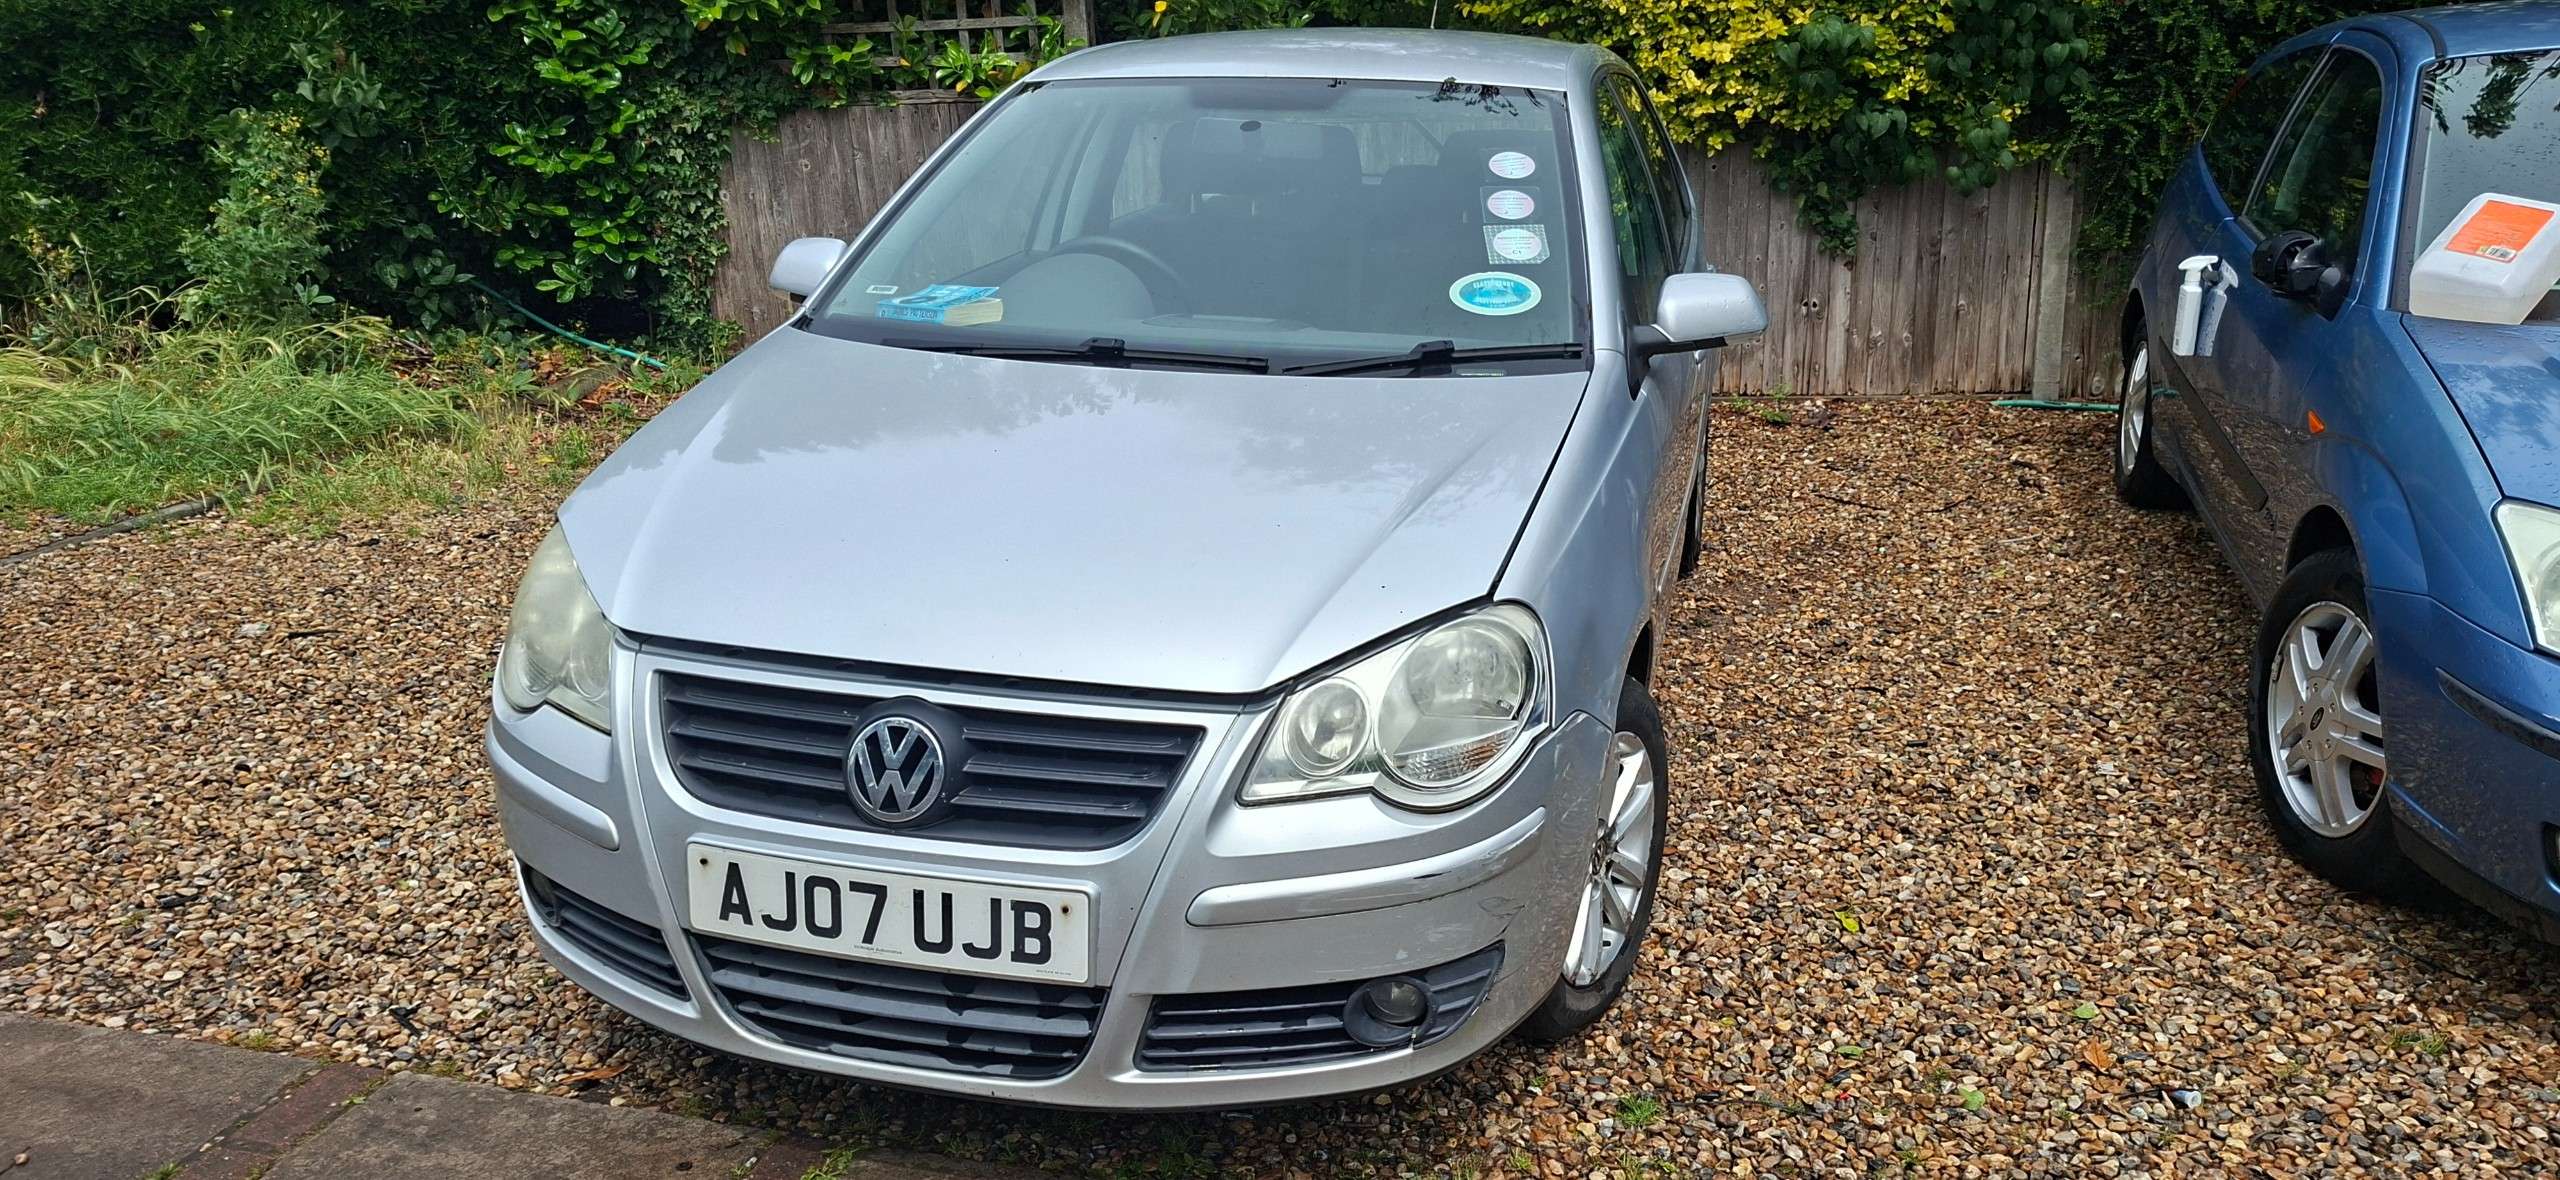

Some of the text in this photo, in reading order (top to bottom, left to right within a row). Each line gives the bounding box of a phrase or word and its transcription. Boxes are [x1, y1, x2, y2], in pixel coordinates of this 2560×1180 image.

[851, 719, 941, 819] VW
[719, 861, 1052, 966] AJ07 UJB
